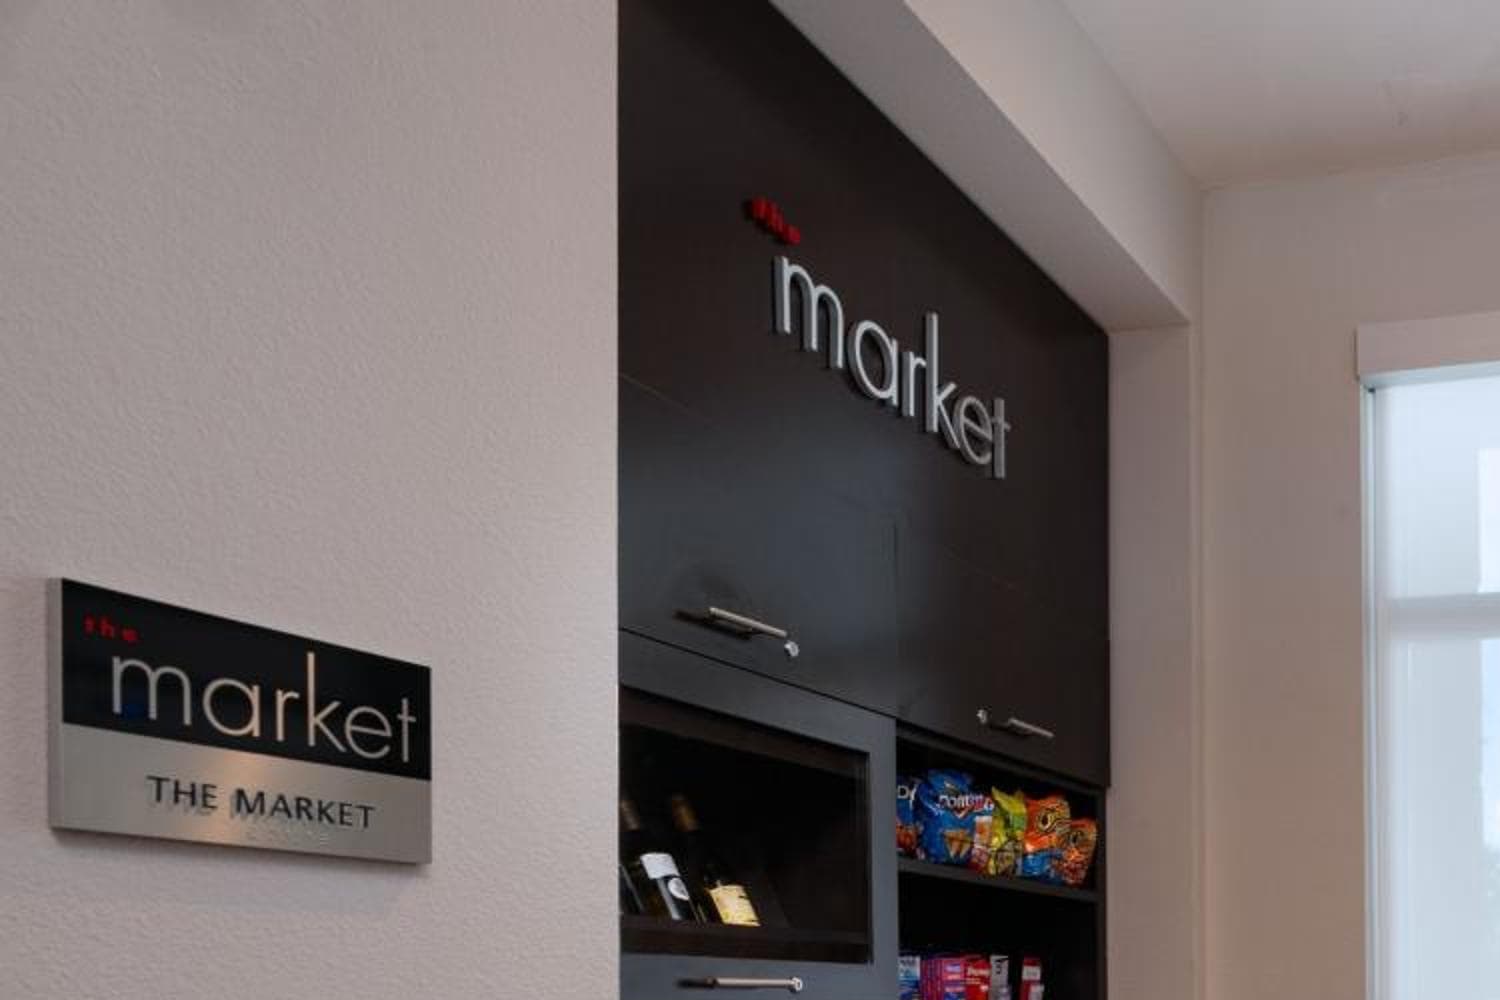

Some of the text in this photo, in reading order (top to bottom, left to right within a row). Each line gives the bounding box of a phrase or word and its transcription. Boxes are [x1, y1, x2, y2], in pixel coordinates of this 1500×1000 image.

[773, 255, 1011, 479] market
[83, 614, 139, 643] the
[112, 650, 417, 763] market
[146, 774, 376, 829] THE MARKET
